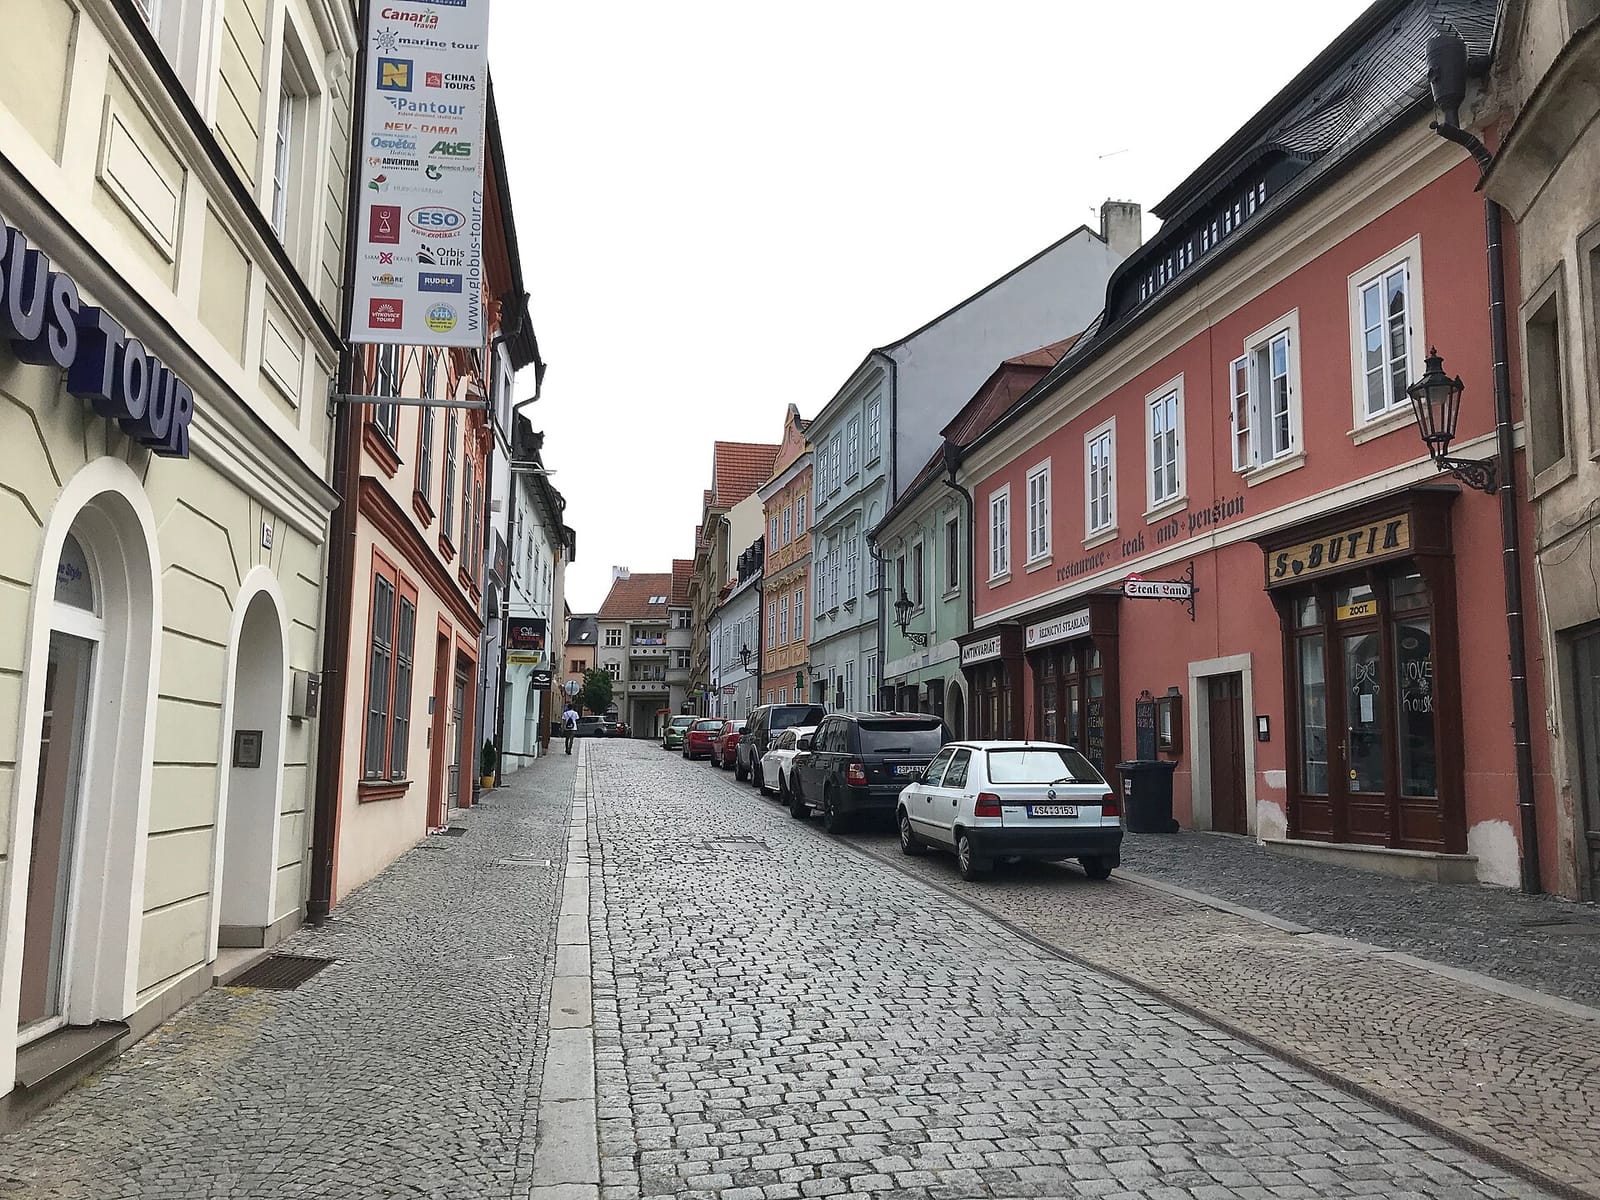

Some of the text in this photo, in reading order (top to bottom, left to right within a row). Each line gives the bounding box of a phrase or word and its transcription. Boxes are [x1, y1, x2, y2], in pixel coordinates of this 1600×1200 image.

[381, 8, 439, 24] Canaria
[413, 22, 437, 30] travel
[398, 37, 447, 48] marine
[451, 41, 480, 50] tour
[382, 62, 408, 88] N
[444, 73, 476, 82] CHINA
[444, 83, 476, 91] TOURS
[398, 97, 466, 116] Pantour
[382, 157, 419, 167] ADVENTURA
[417, 211, 459, 227] ESO
[410, 228, 461, 239] www.exotika.cz
[436, 247, 465, 258] Orbis
[440, 256, 462, 267] Link
[466, 190, 482, 331] www.globus-tour.cz
[424, 276, 455, 285] RUDOLF
[98, 306, 195, 460] TOUR
[1156, 518, 1179, 545] and
[1188, 491, 1245, 537] pension
[1307, 519, 1402, 569] BUTIK
[1127, 584, 1188, 596] Steak Land
[963, 639, 996, 660] ANTIKVARIÁT
